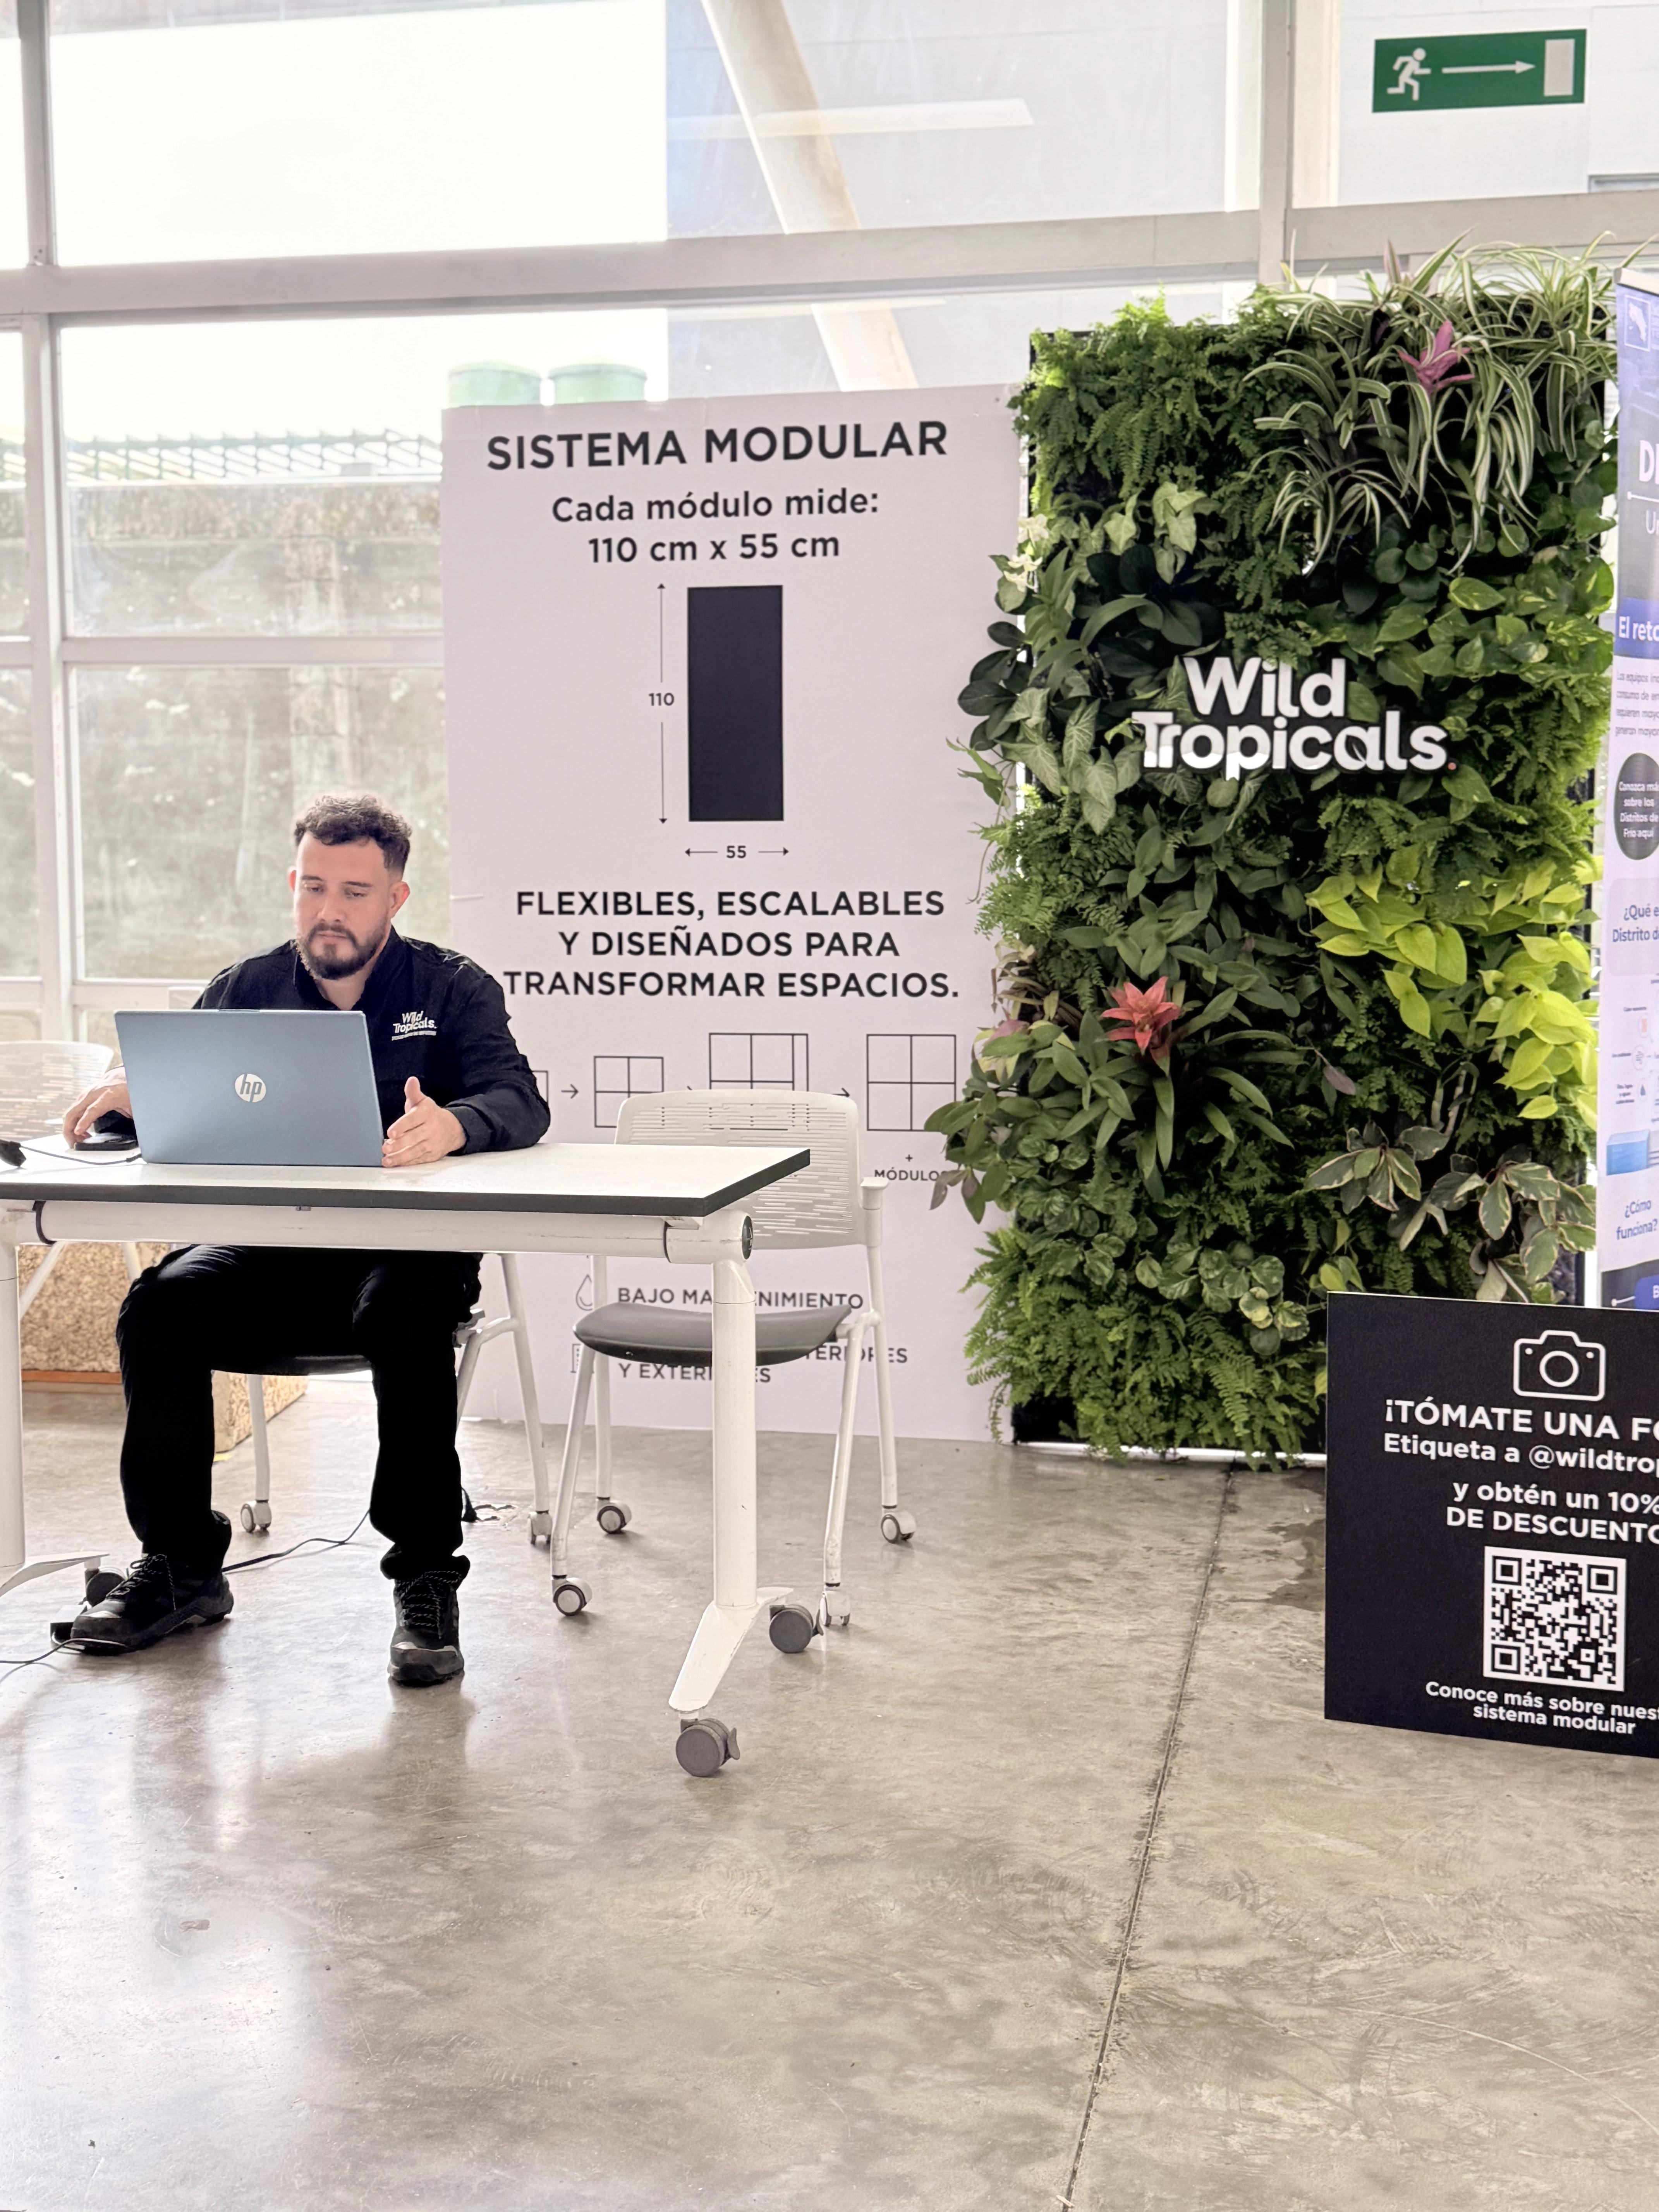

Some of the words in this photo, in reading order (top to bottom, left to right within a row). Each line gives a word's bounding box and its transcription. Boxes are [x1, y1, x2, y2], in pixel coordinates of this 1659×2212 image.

[487, 430, 687, 471] SISTEMA
[705, 421, 947, 464] MODULAR
[552, 494, 634, 523] Cada
[647, 490, 773, 520] módulo
[785, 487, 878, 516] mide:
[588, 536, 637, 563] 110
[650, 541, 697, 562] cm
[709, 540, 727, 560] x
[739, 532, 778, 560] 55
[791, 536, 839, 558] cm
[1619, 616, 1630, 639] El
[648, 692, 675, 707] 110
[1182, 657, 1347, 717] Wild
[726, 845, 747, 859] 55
[517, 891, 704, 921] FLEXIBLES,
[718, 890, 945, 916] ESCALABLES
[1624, 903, 1650, 921] ¿Qué
[558, 931, 579, 956] Y
[592, 925, 792, 957] DISEÑADOS
[806, 931, 900, 957] PARA
[1613, 927, 1650, 942] Distrito
[1652, 927, 1659, 940] d
[503, 970, 766, 996] TRANSFORMAR
[778, 972, 958, 998] ESPACIOS.
[239, 1073, 263, 1103] hp
[874, 1167, 947, 1181] MÓDULO
[1625, 1200, 1652, 1218] ¿Cómo
[1616, 1218, 1658, 1240] funciona?
[617, 1286, 676, 1305] BAJO
[682, 1290, 864, 1310] MANIMIENTO
[617, 1362, 632, 1379] Y
[1385, 1396, 1533, 1434] ¡TÓMATE
[1544, 1411, 1620, 1440] UNA
[1631, 1417, 1659, 1441] F
[1384, 1433, 1496, 1460] Etiqueta
[1504, 1448, 1520, 1463] a
[1528, 1444, 1659, 1479] @wildtro
[1453, 1482, 1469, 1502] y
[1477, 1481, 1557, 1506] obtén
[1566, 1492, 1599, 1510] un
[1446, 1506, 1484, 1529] DE
[1425, 1681, 1498, 1702] Conoce
[1504, 1691, 1544, 1709] más
[1549, 1697, 1605, 1714] sobre
[1610, 1704, 1659, 1721] nues
[1473, 1704, 1547, 1725] sistema
[1553, 1714, 1636, 1735] modular
